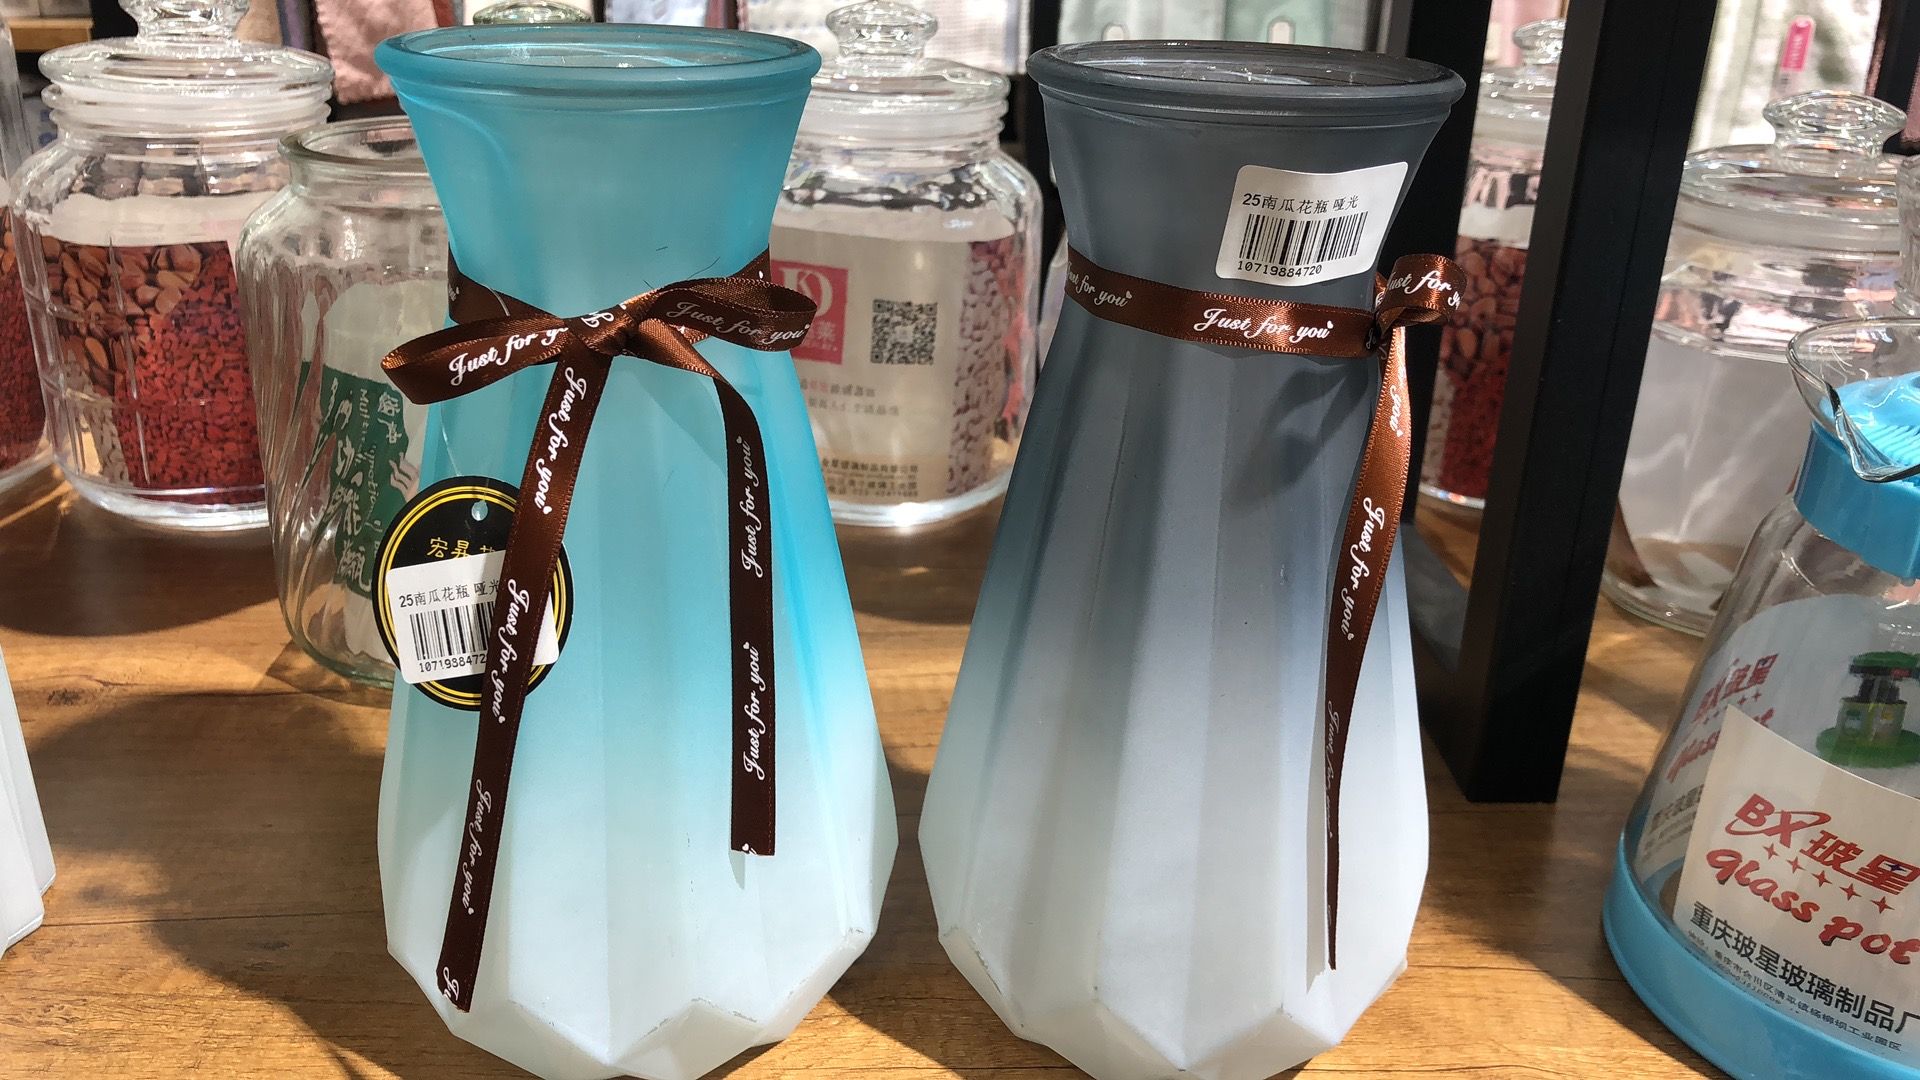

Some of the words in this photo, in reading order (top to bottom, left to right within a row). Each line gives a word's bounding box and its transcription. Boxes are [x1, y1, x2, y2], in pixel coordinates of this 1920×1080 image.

[1242, 192, 1330, 214] 25南瓜花瓶
[1332, 195, 1359, 211] 哑光
[1075, 275, 1097, 294] for
[1094, 288, 1130, 307] you
[1237, 261, 1323, 277] 10719884720
[1405, 270, 1452, 294] for
[666, 301, 725, 327] Just
[716, 319, 763, 338] for
[761, 327, 806, 345] you
[1193, 308, 1252, 332] Just
[1244, 316, 1292, 339] for
[1289, 323, 1331, 343] you
[449, 348, 500, 386] Just
[496, 333, 539, 366] for
[557, 366, 588, 422] Just
[548, 412, 569, 461] for
[535, 458, 552, 512] you
[741, 439, 760, 487] you
[739, 486, 762, 531] for
[1364, 497, 1385, 553] Just
[741, 524, 764, 578] Just
[1350, 544, 1370, 590] for
[399, 583, 471, 608] 25南瓜花瓶
[507, 579, 531, 636] Just
[1341, 587, 1355, 638] you
[419, 653, 488, 673] 1071988472
[498, 626, 518, 674] for
[747, 644, 766, 692] you
[491, 669, 506, 722] you
[744, 690, 766, 734] for
[743, 728, 765, 781] Just
[475, 779, 492, 832] Just
[469, 822, 483, 867] for
[1733, 793, 1812, 848] BX
[1799, 829, 1920, 896] 玻星
[461, 861, 475, 912] you
[1819, 916, 1920, 965] pot
[1690, 900, 1920, 1034] 重庆玻星玻璃制品厂
